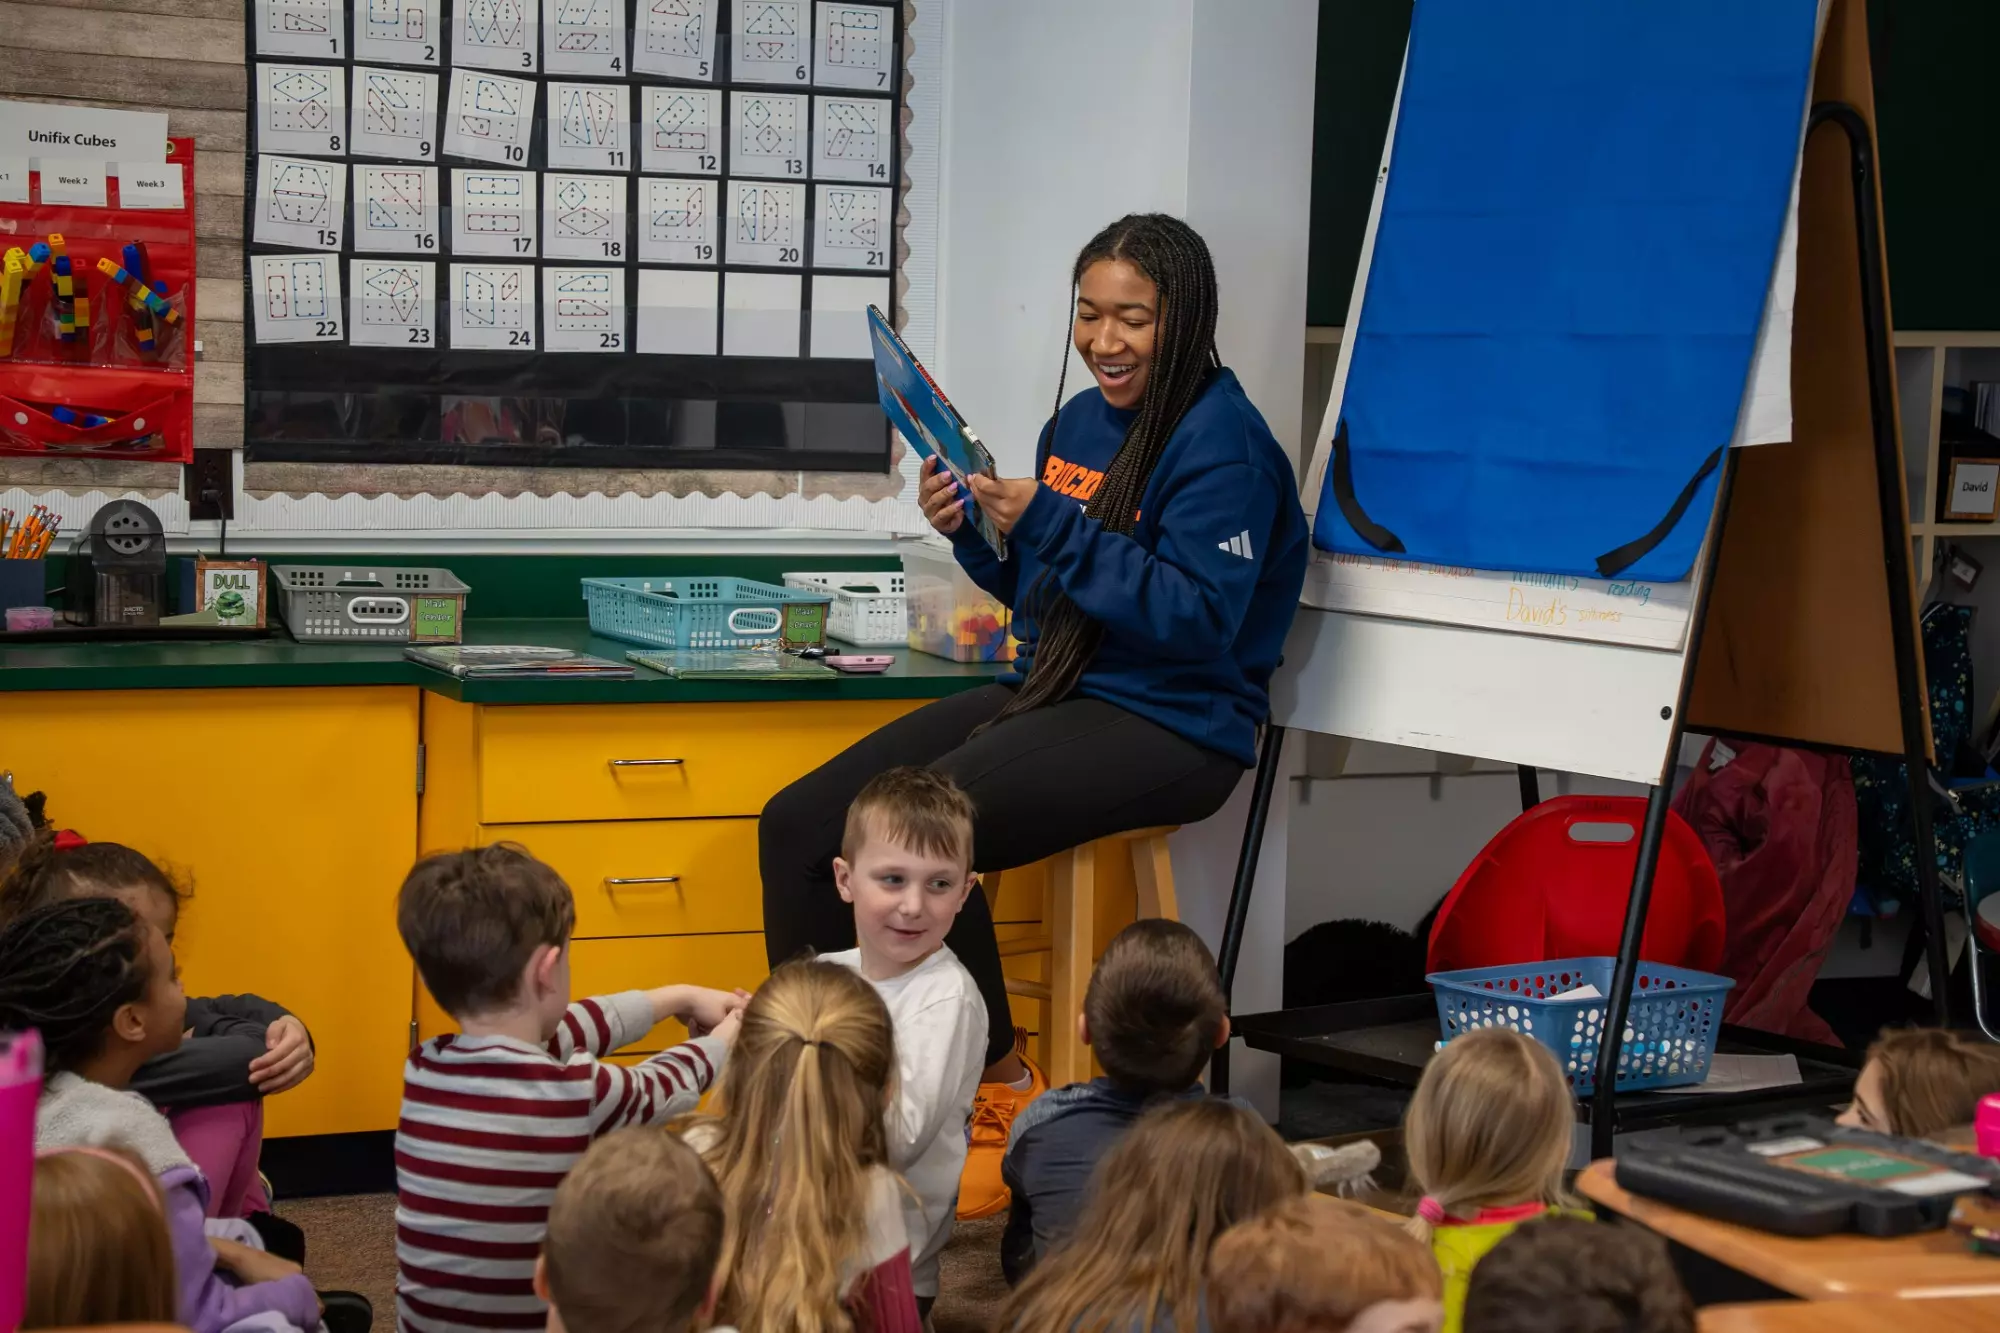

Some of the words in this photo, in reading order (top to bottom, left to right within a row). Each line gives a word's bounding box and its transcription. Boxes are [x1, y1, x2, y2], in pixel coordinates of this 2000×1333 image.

[329, 39, 337, 53] 1
[424, 46, 435, 61] 2
[522, 53, 532, 67] 3
[610, 57, 621, 72] 4
[699, 61, 708, 76] 5
[796, 65, 806, 80] 6
[877, 72, 886, 86] 7
[29, 130, 70, 144] Unifix
[74, 133, 116, 148] Cubes
[330, 136, 341, 151] 8
[420, 142, 431, 156] 9
[504, 145, 524, 161] 10
[608, 152, 624, 166] 11
[698, 155, 716, 170] 12
[785, 160, 802, 174] 13
[868, 164, 886, 178] 14
[59, 176, 81, 184] Week
[137, 180, 158, 188] Week
[317, 230, 337, 246] 15
[414, 234, 434, 248] 16
[513, 238, 532, 252] 17
[602, 242, 621, 256] 18
[694, 245, 712, 259] 19
[779, 248, 799, 262] 20
[867, 251, 883, 265] 21
[315, 321, 337, 336] 22
[408, 328, 430, 343] 23
[509, 331, 530, 345] 24
[600, 333, 620, 348] 25
[1962, 481, 1988, 492] David
[213, 573, 250, 590] DULL
[1607, 581, 1651, 606] reading
[1506, 586, 1567, 626] David's
